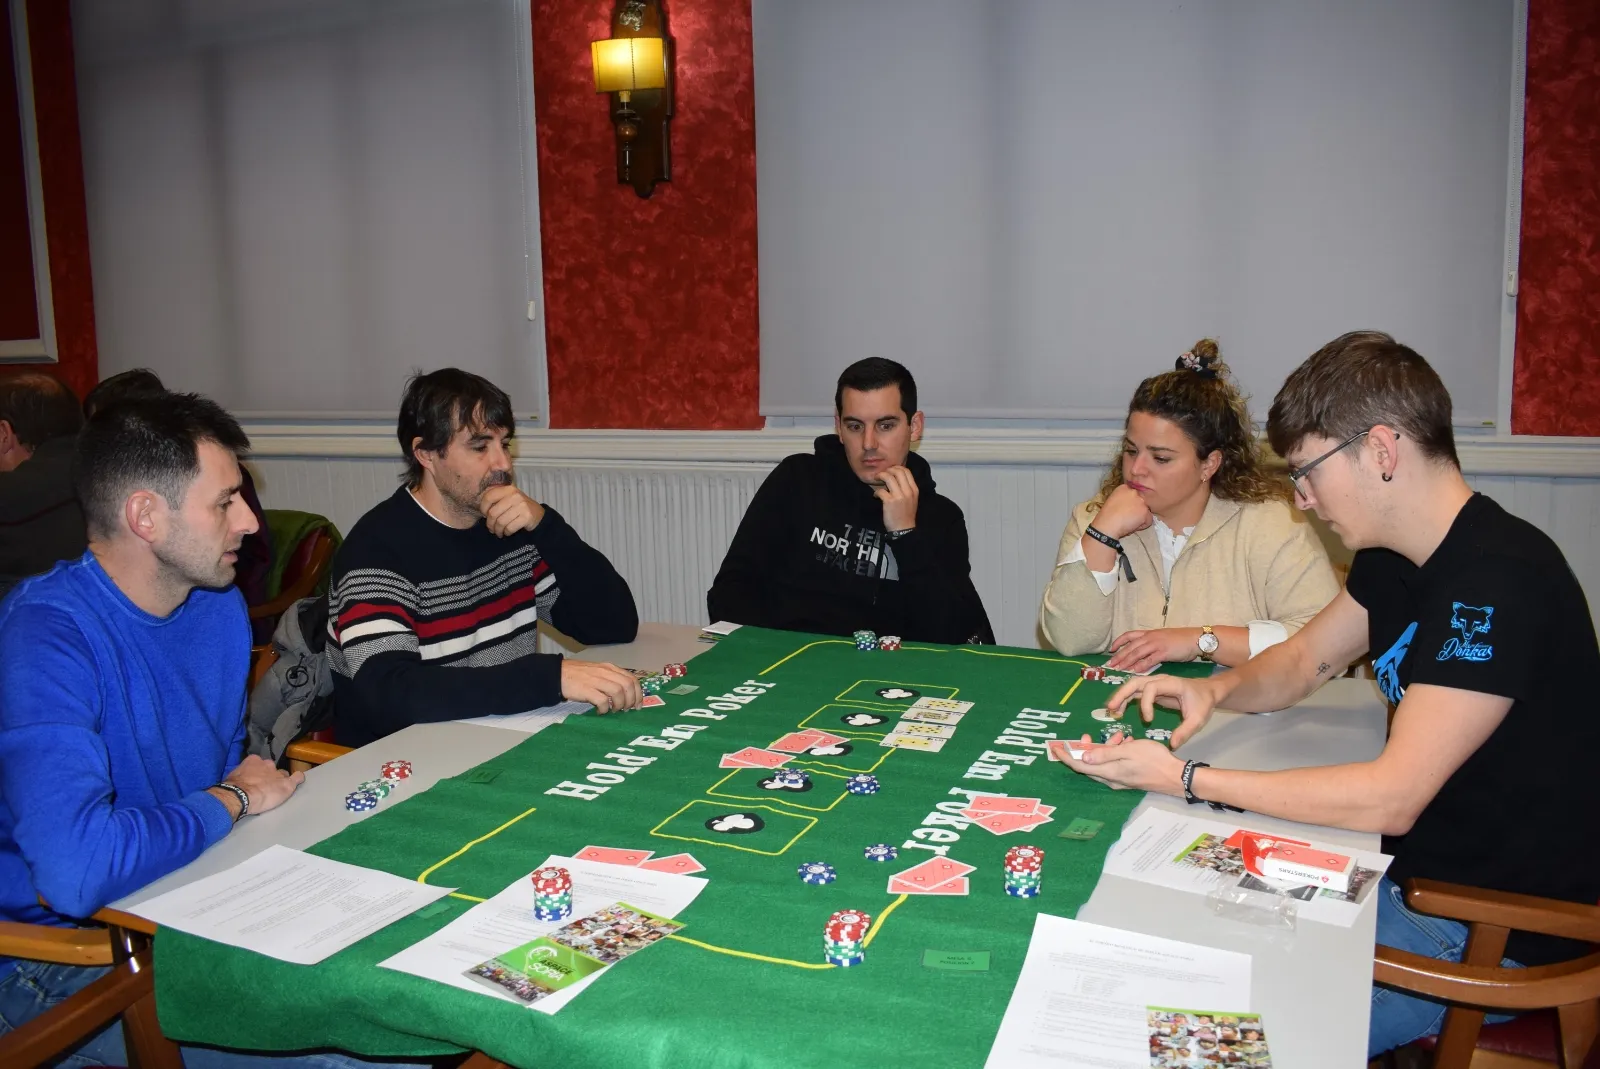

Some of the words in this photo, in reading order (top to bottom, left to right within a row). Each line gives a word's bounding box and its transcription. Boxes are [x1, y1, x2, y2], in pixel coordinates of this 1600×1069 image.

[680, 680, 777, 721] Poker
[528, 963, 565, 982] SORIA
[539, 959, 574, 975] ASPACE
